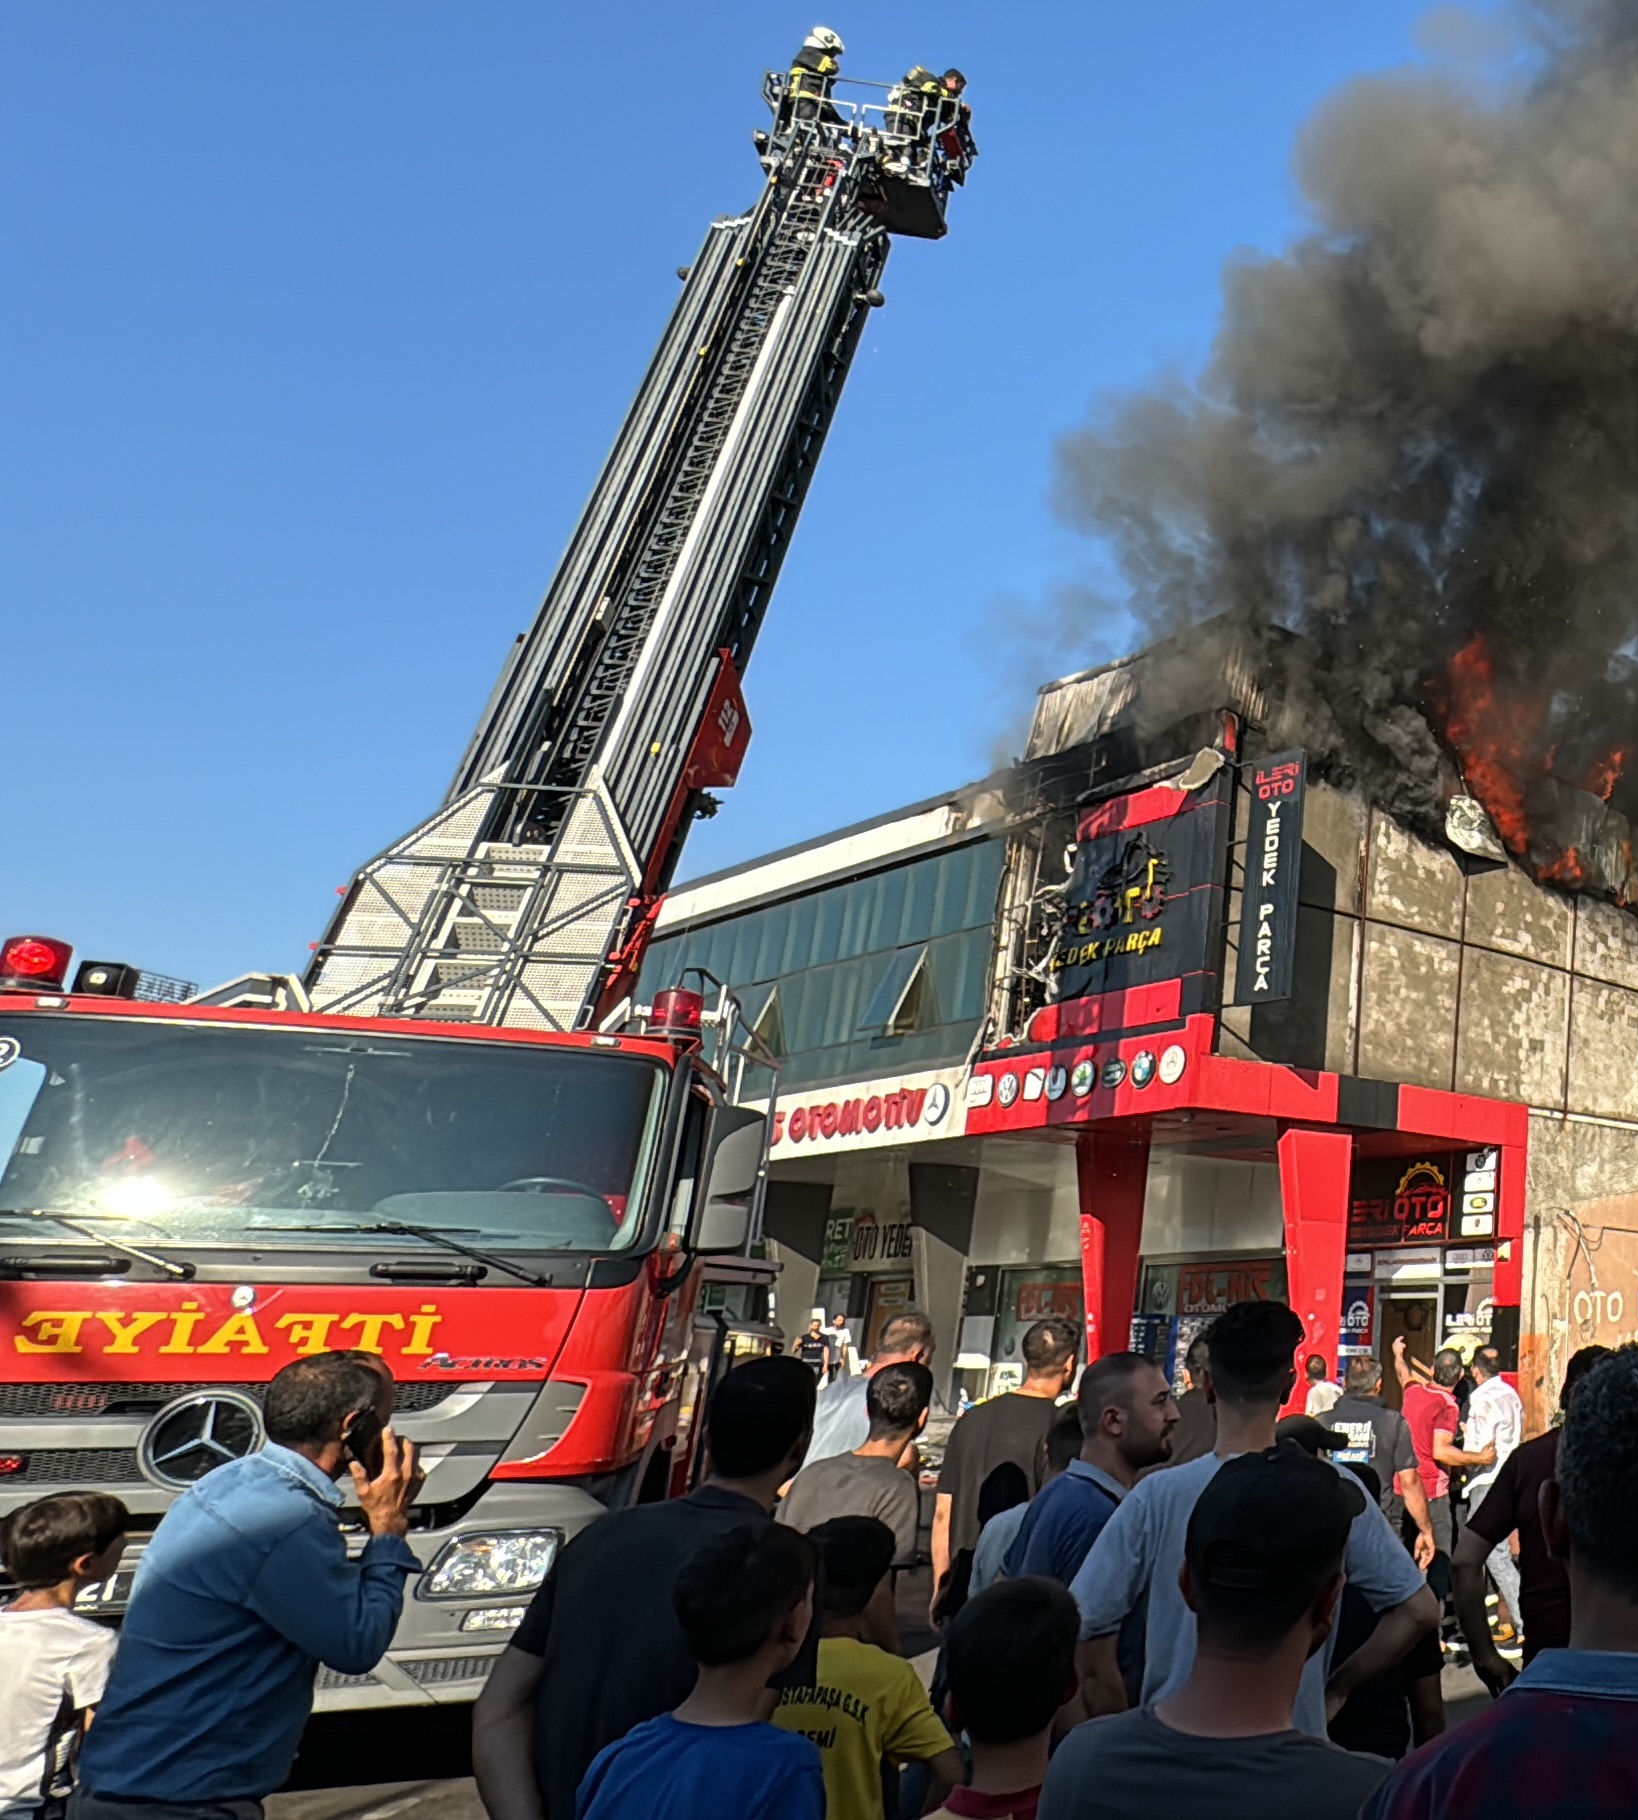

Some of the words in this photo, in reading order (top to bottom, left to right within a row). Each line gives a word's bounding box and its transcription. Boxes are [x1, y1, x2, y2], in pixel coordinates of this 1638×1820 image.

[1258, 779, 1295, 801] OTO
[1261, 801, 1282, 888] YEDEK
[1253, 903, 1274, 992] PARÇA
[788, 1087, 929, 1144] OTOMOTİV
[1393, 1194, 1444, 1220] OTO
[854, 1225, 879, 1260] OTO
[881, 1222, 912, 1259] YEDE
[1573, 1290, 1623, 1324] OTO
